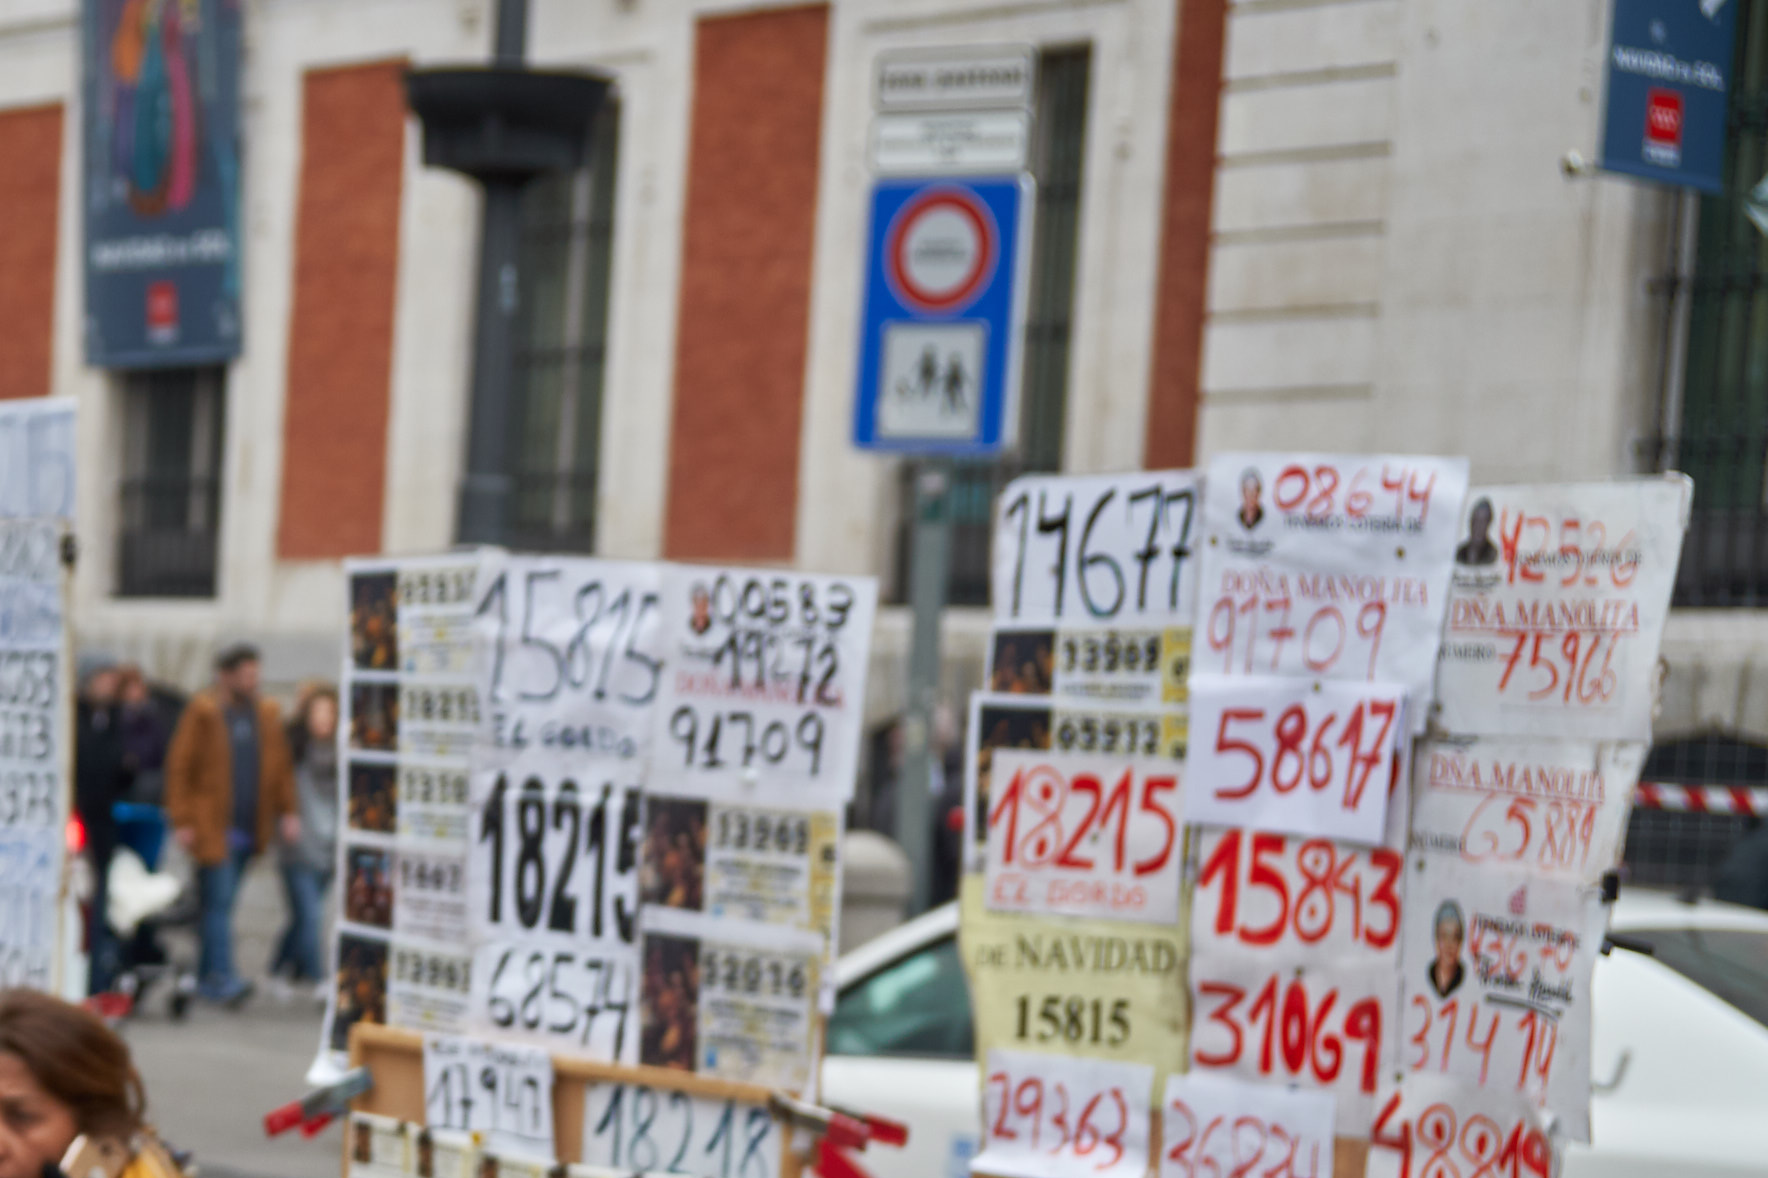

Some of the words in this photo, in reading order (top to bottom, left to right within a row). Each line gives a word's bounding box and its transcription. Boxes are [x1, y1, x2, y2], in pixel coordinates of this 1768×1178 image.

[1005, 483, 1196, 619] 14677
[475, 570, 665, 709] 15815
[669, 704, 825, 777] 91709
[1214, 698, 1396, 813] 58617
[989, 764, 1179, 878] 18215
[1199, 827, 1404, 951] 15843
[1015, 932, 1177, 974] NAVIDAD
[1015, 993, 1131, 1048] 15815
[1194, 971, 1381, 1095] 31069
